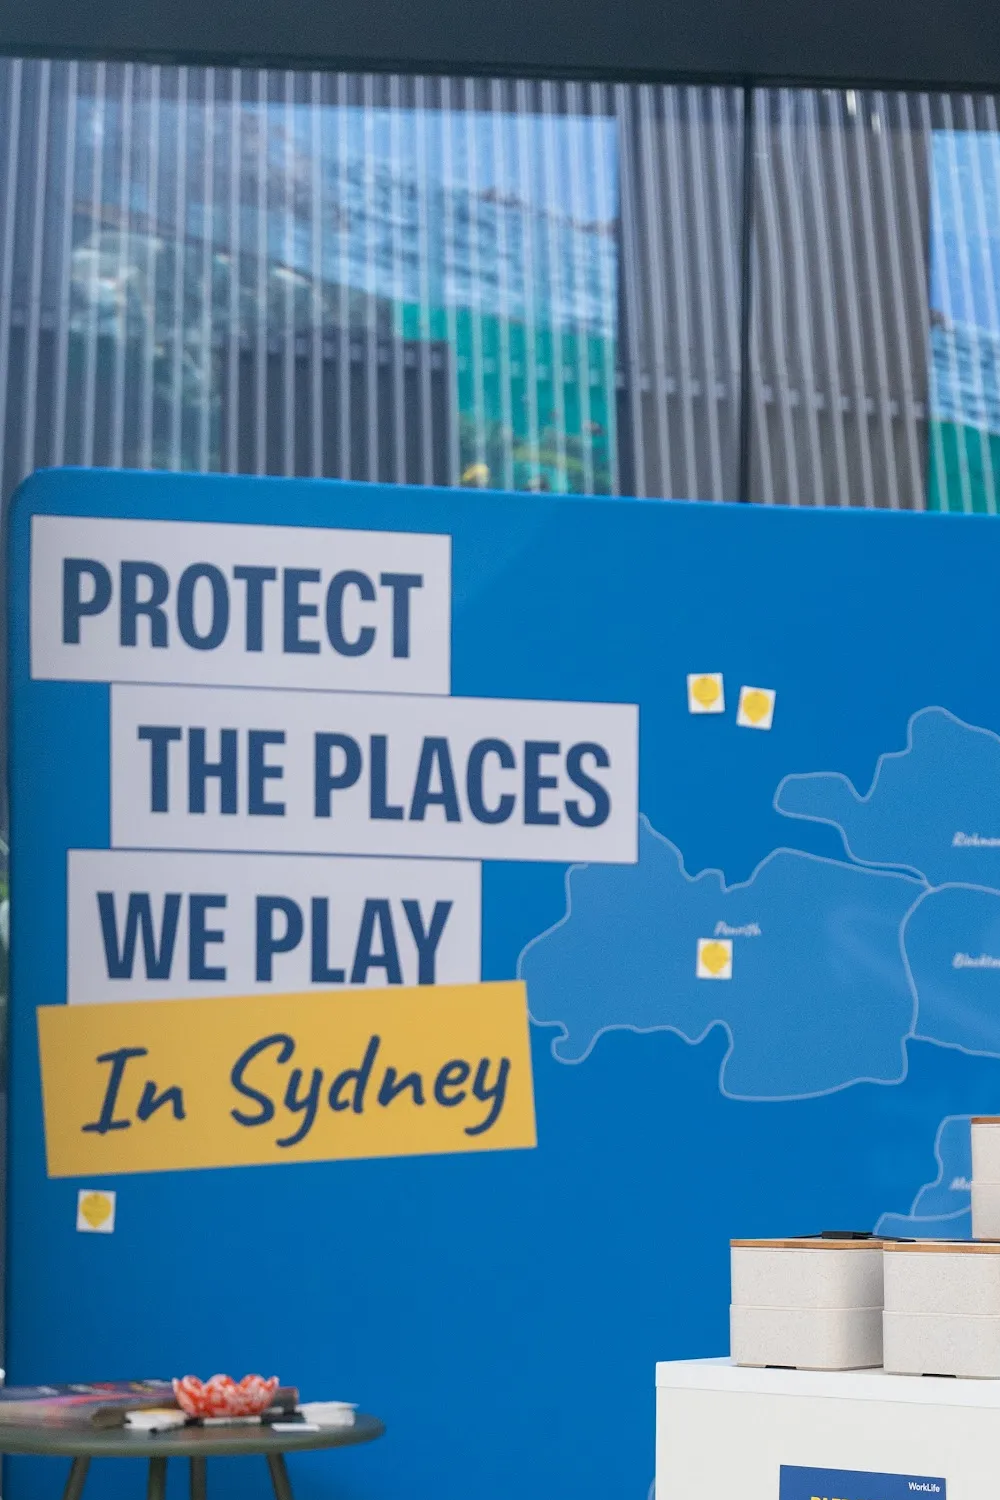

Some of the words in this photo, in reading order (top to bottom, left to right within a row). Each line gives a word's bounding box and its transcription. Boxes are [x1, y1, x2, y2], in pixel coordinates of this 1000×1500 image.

[60, 556, 424, 660] PROTECT
[137, 725, 286, 817] THE
[313, 731, 611, 828] PLACES
[96, 890, 227, 982] WE
[255, 895, 453, 986] PLAY
[82, 1046, 187, 1135] In
[229, 1033, 511, 1148] Sydney
[908, 1482, 940, 1493] WorkLife
